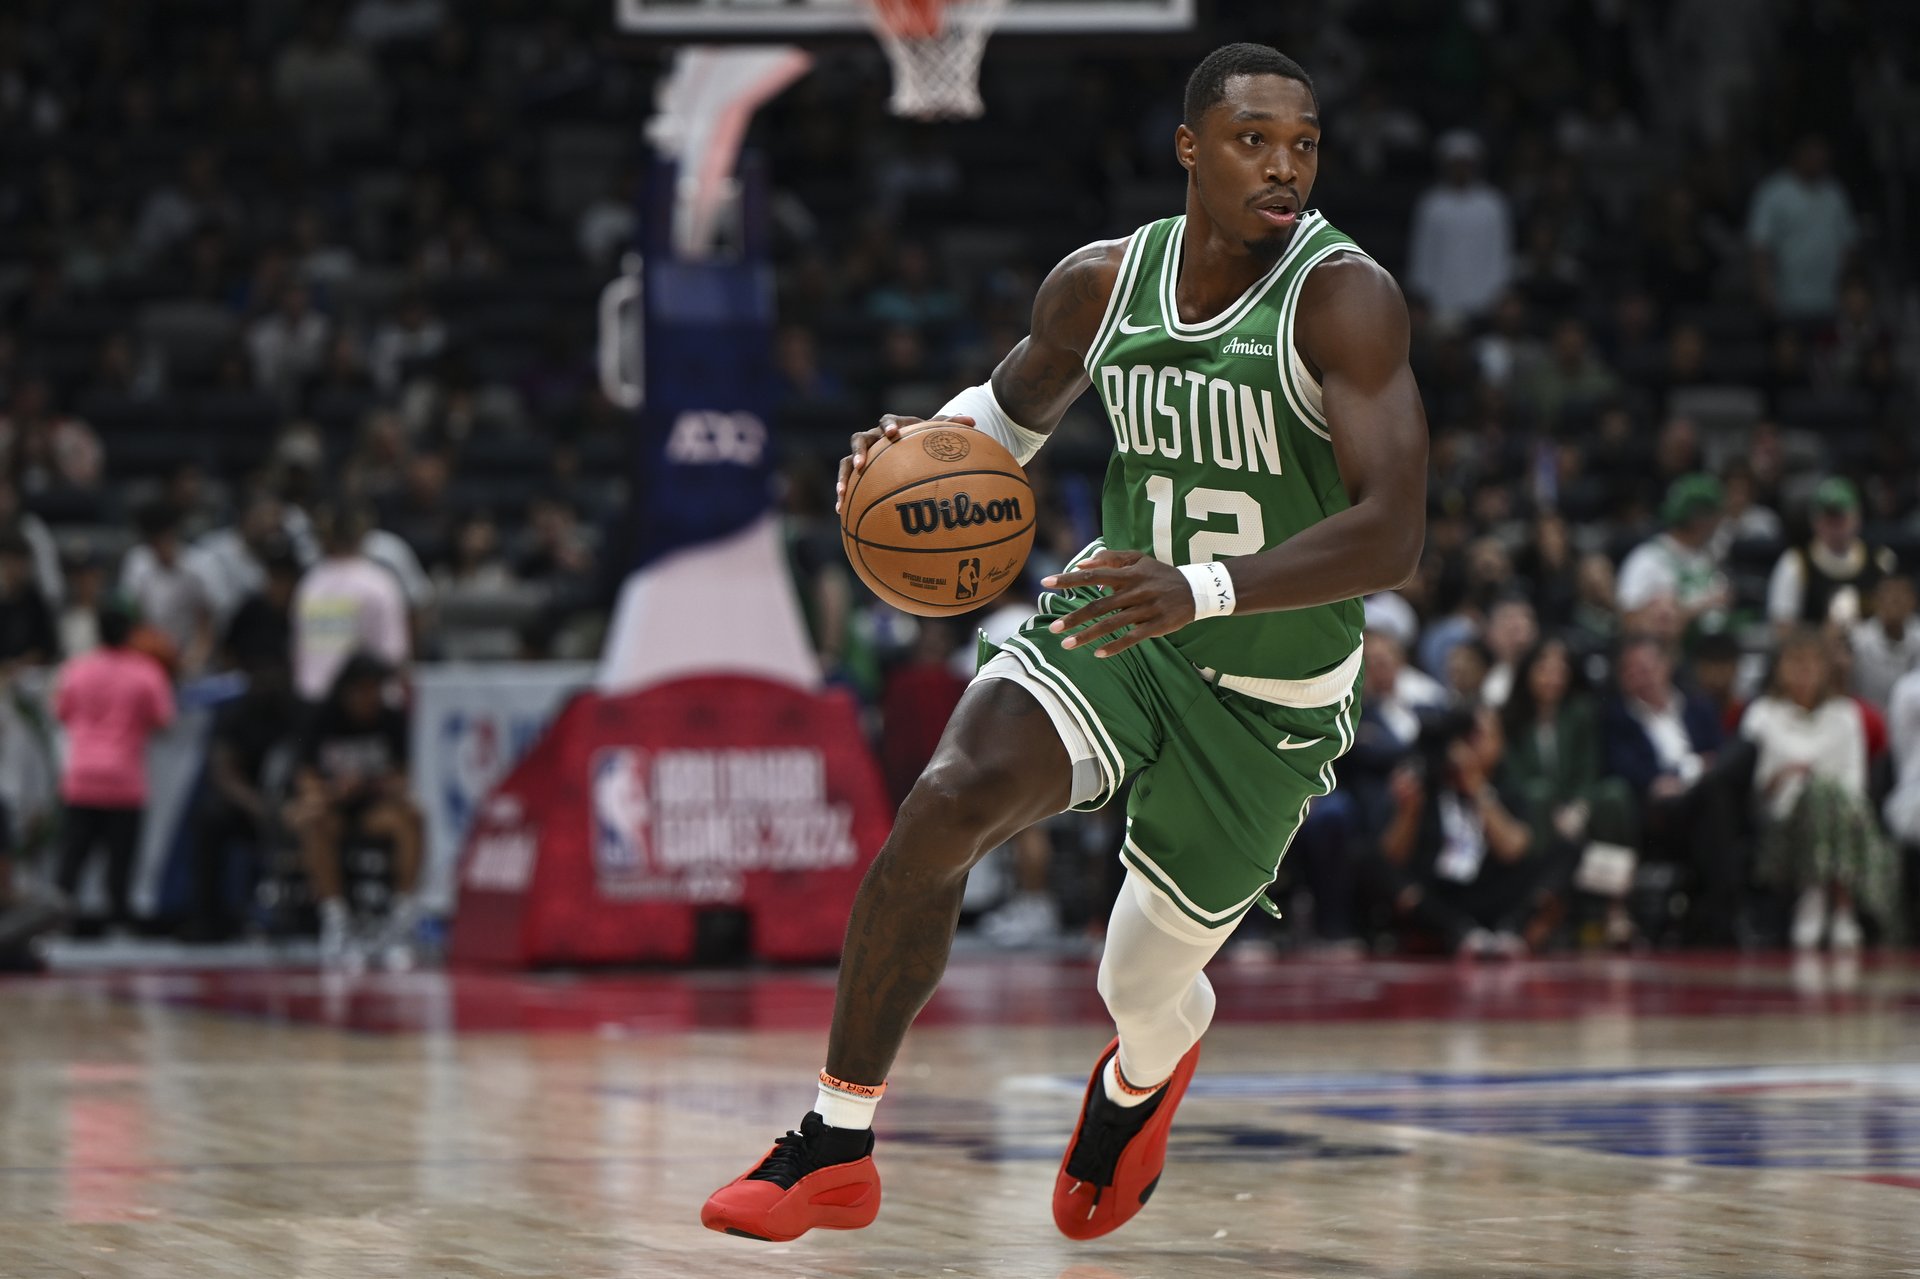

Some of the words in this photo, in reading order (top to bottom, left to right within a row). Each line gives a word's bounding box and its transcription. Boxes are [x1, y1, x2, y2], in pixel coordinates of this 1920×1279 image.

[1222, 336, 1273, 357] Amica
[1101, 364, 1283, 476] BOSTON
[895, 491, 1022, 536] Wilson
[1145, 474, 1265, 567] 12
